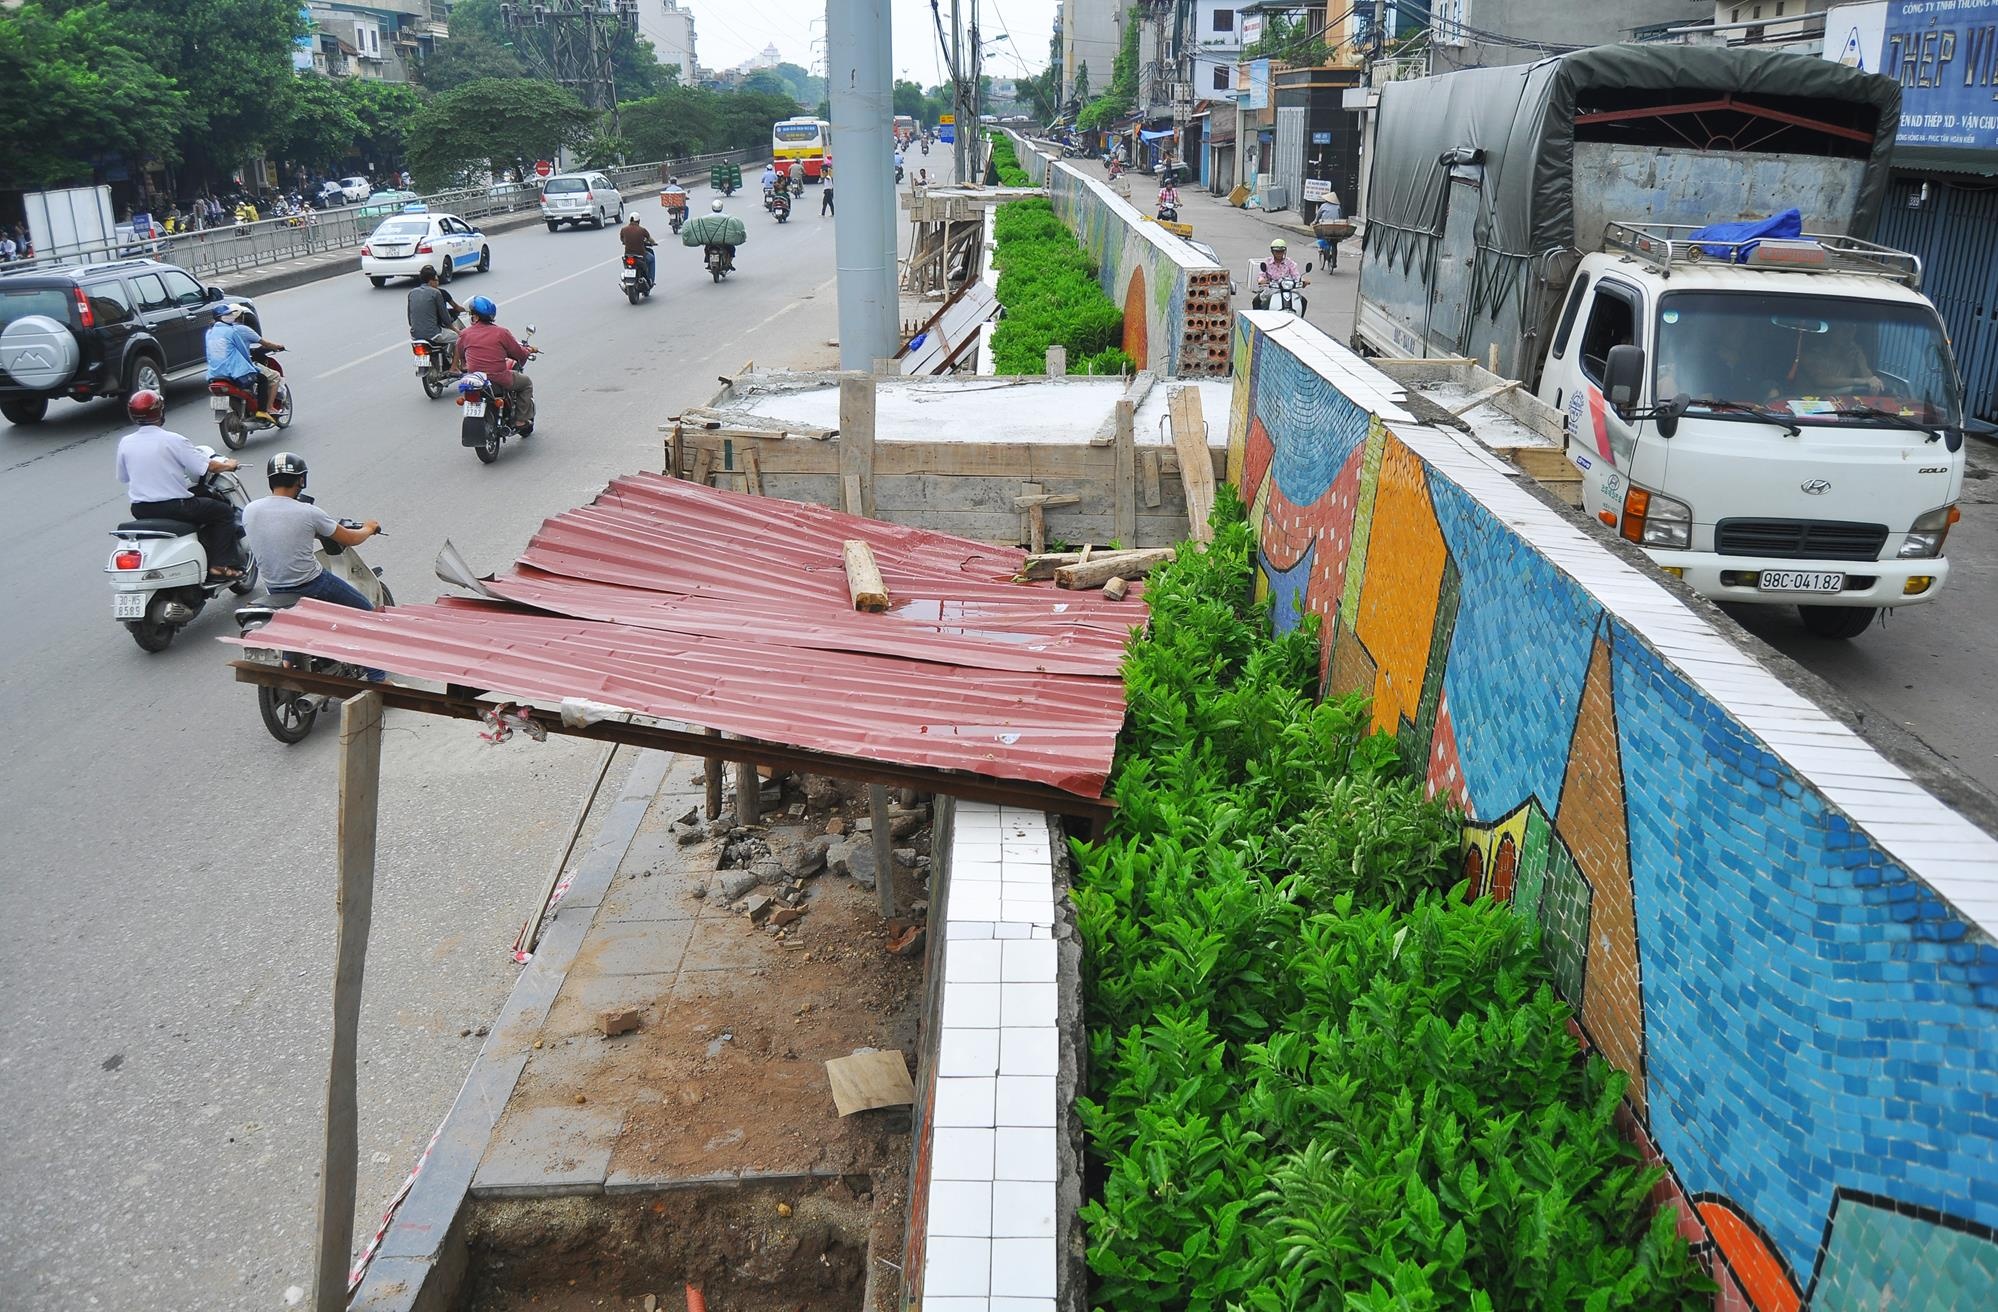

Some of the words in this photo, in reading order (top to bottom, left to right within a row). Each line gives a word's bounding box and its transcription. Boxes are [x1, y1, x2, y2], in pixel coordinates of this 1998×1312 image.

[1903, 2, 1924, 15] CÔNG
[1925, 2, 1936, 12] TY
[1936, 1, 1956, 11] TNHH
[1888, 16, 1956, 89] THÉP
[1924, 112, 1943, 128] THÉP
[1943, 115, 1955, 128] XD
[1762, 572, 1841, 590] 98C-041.82
[118, 606, 140, 616] 8589
